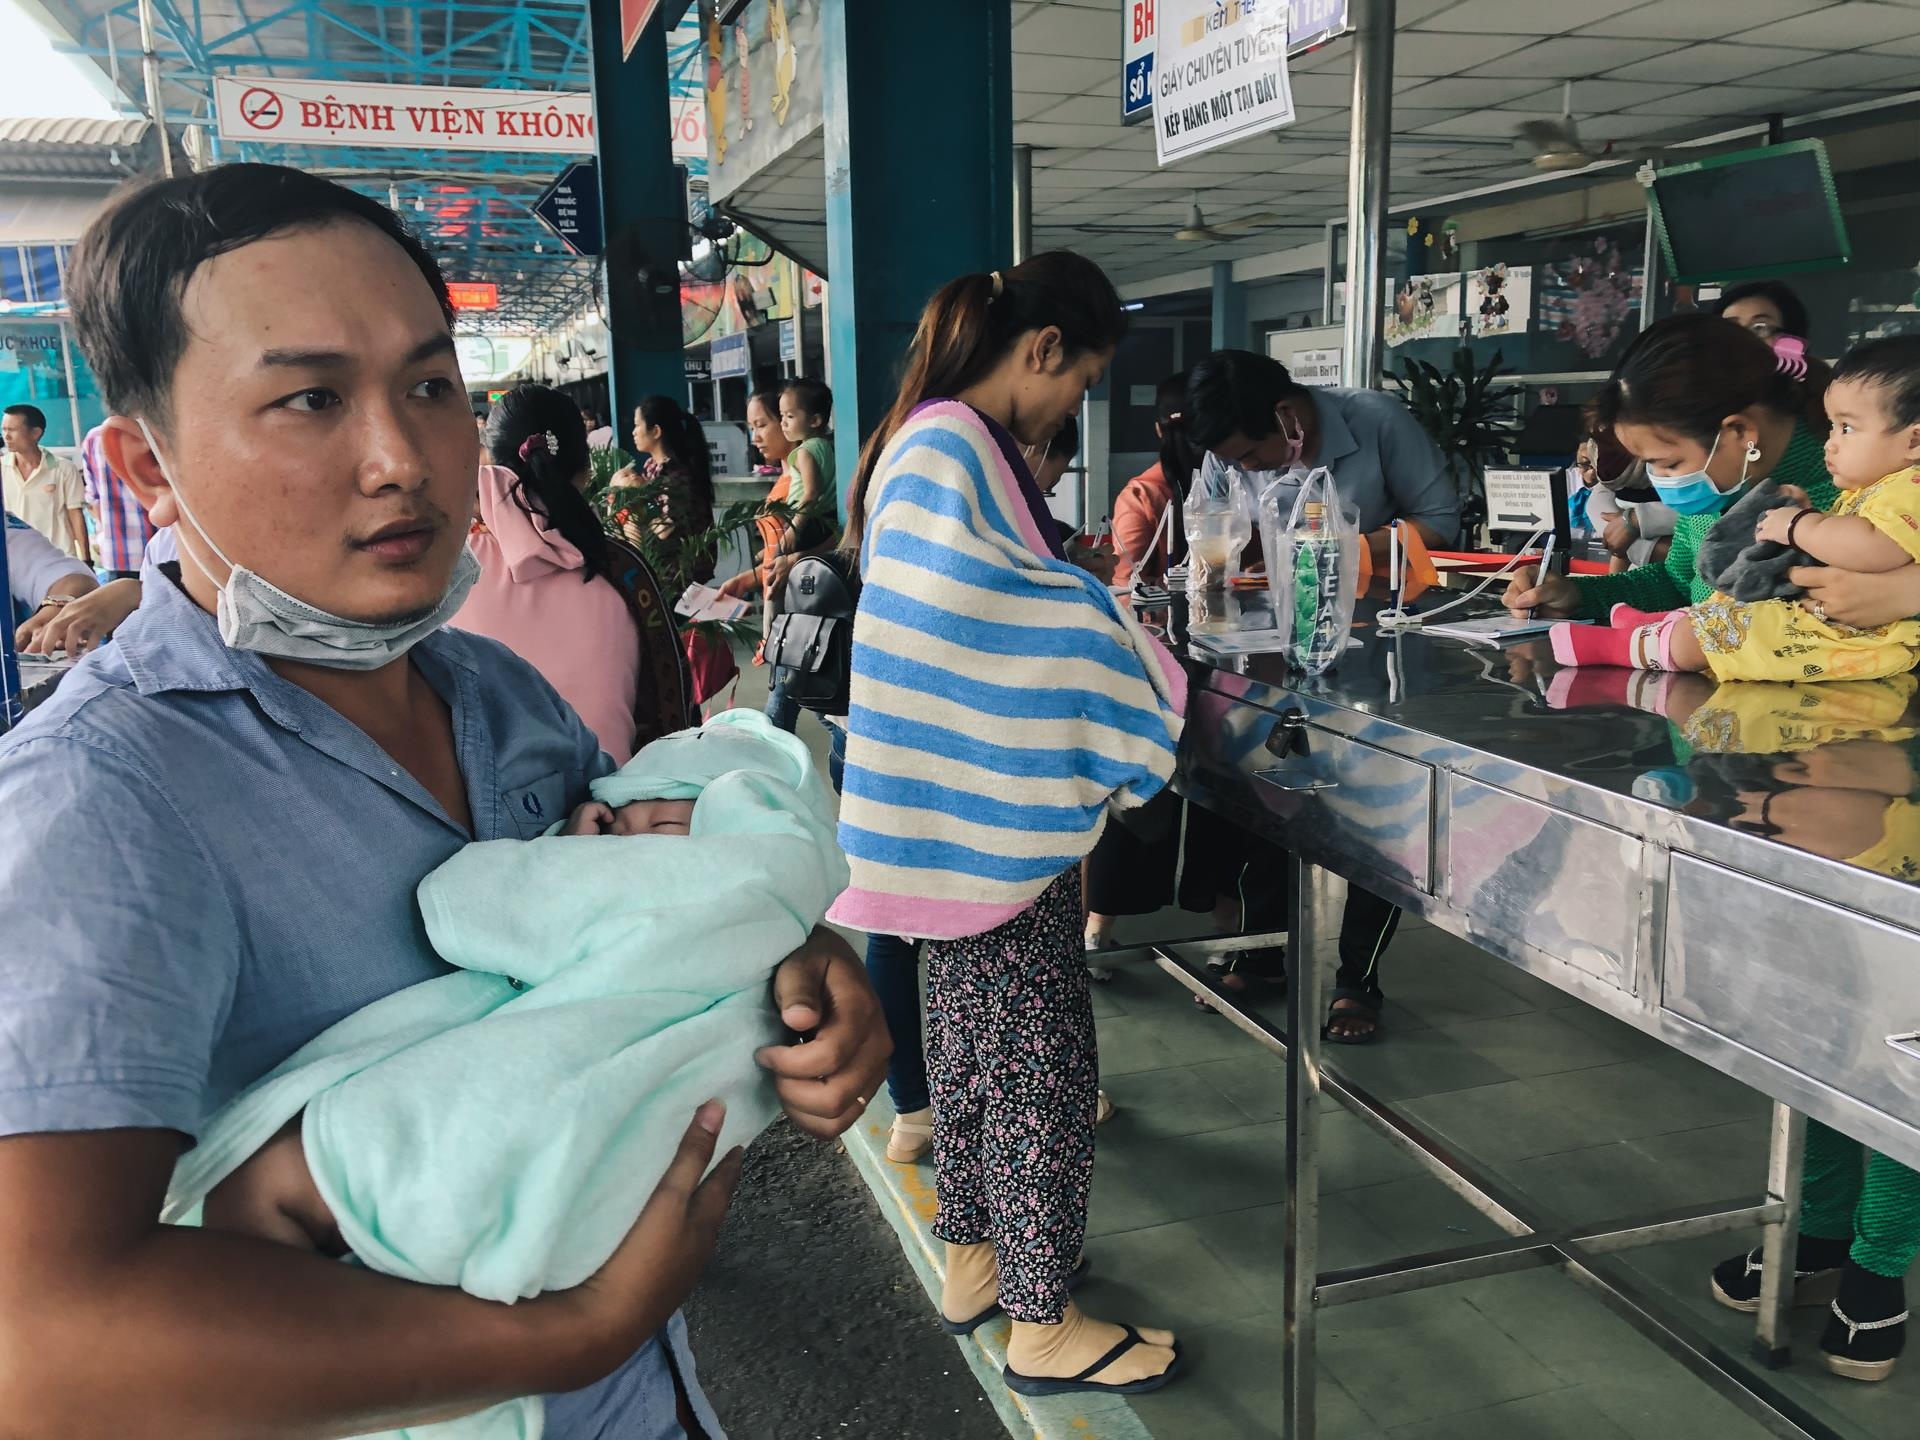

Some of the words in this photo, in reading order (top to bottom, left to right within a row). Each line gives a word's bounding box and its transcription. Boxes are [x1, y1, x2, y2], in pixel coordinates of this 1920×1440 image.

[299, 95, 395, 136] BỆNH
[406, 100, 484, 140] VIỆN
[1164, 106, 1180, 138] XẾP
[1183, 100, 1210, 131] HÀNG
[1211, 90, 1233, 122] MỘT
[1235, 82, 1254, 114] TẠI
[1255, 73, 1278, 106] ĐÂY
